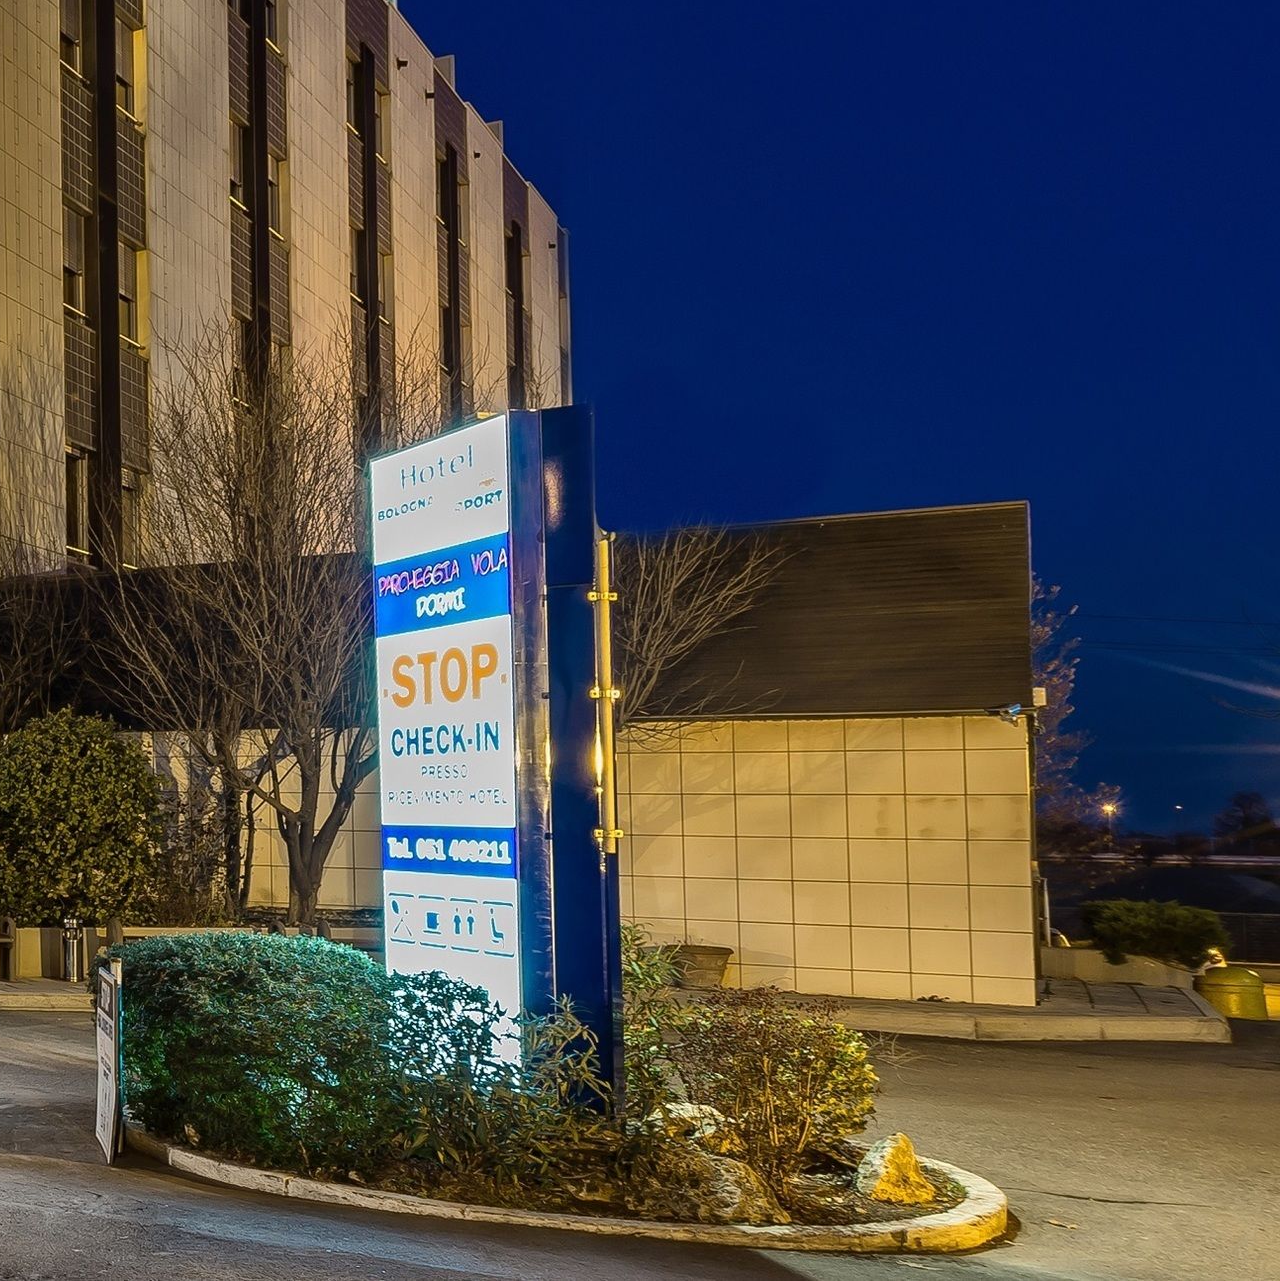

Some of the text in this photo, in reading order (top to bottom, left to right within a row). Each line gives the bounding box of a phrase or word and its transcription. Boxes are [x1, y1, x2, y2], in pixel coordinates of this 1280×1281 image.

[401, 445, 473, 489] Hotel
[378, 548, 508, 597] PARCHEGGIA VOLA
[391, 643, 499, 709] STOP
[391, 721, 500, 757] CHECK-IN
[421, 764, 468, 779] PRESSO
